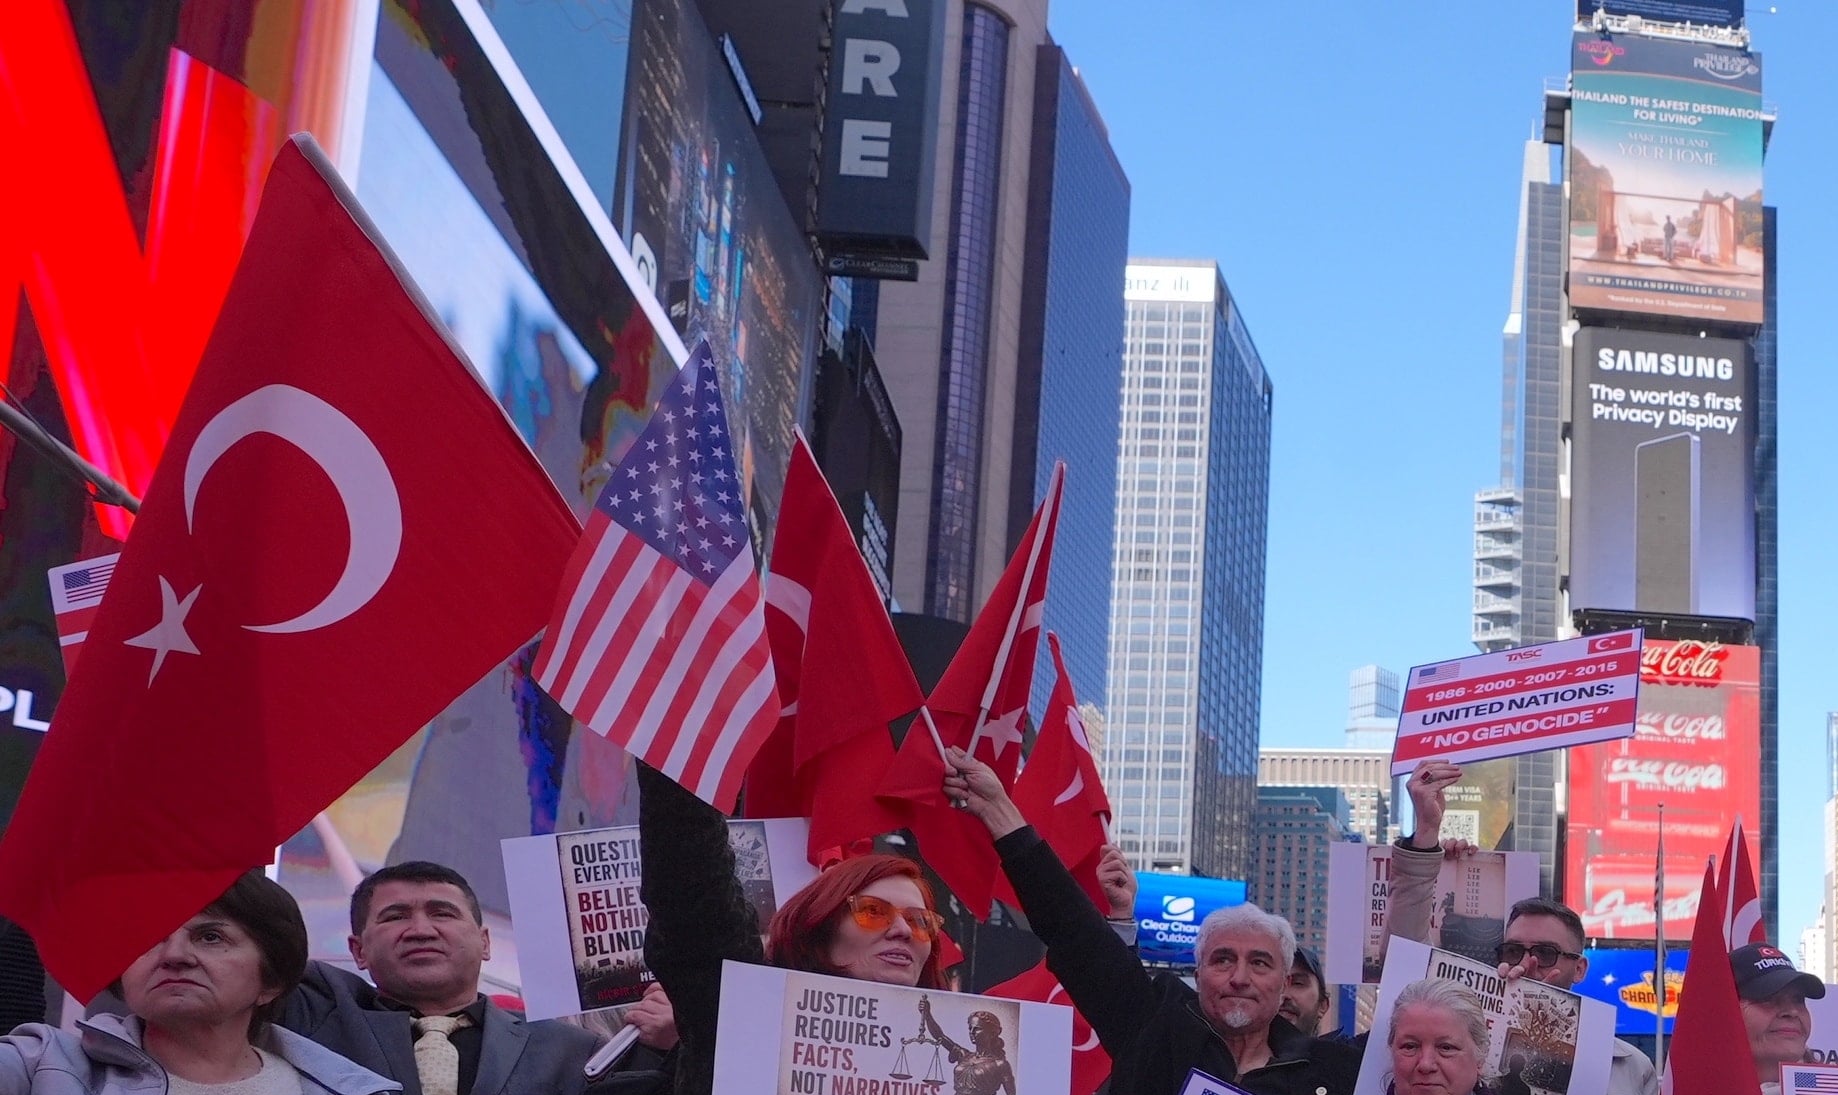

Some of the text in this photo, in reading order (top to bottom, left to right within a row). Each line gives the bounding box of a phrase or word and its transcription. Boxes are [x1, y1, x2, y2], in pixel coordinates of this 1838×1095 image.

[1572, 90, 1764, 120] THAILAND THE SAFEST DESTINATION
[1634, 110, 1656, 122] FOR
[1619, 142, 1717, 166] YOUR HOME
[1659, 136, 1709, 148] THAILAND
[1598, 347, 1733, 380] SAMSUNG
[1589, 383, 1742, 411] The world's first
[1592, 402, 1738, 434] Privacy Display
[1505, 648, 1543, 663] TASC
[1421, 683, 1615, 727] UNITED NATIONS:
[571, 839, 641, 866] QUESTI
[578, 885, 641, 913] BELIE
[1141, 919, 1170, 931] Clear
[796, 988, 879, 1021] JUSTICE
[794, 1014, 891, 1049] REQUIRES
[792, 1042, 858, 1075] FACTS,
[790, 1070, 824, 1095] NOT
